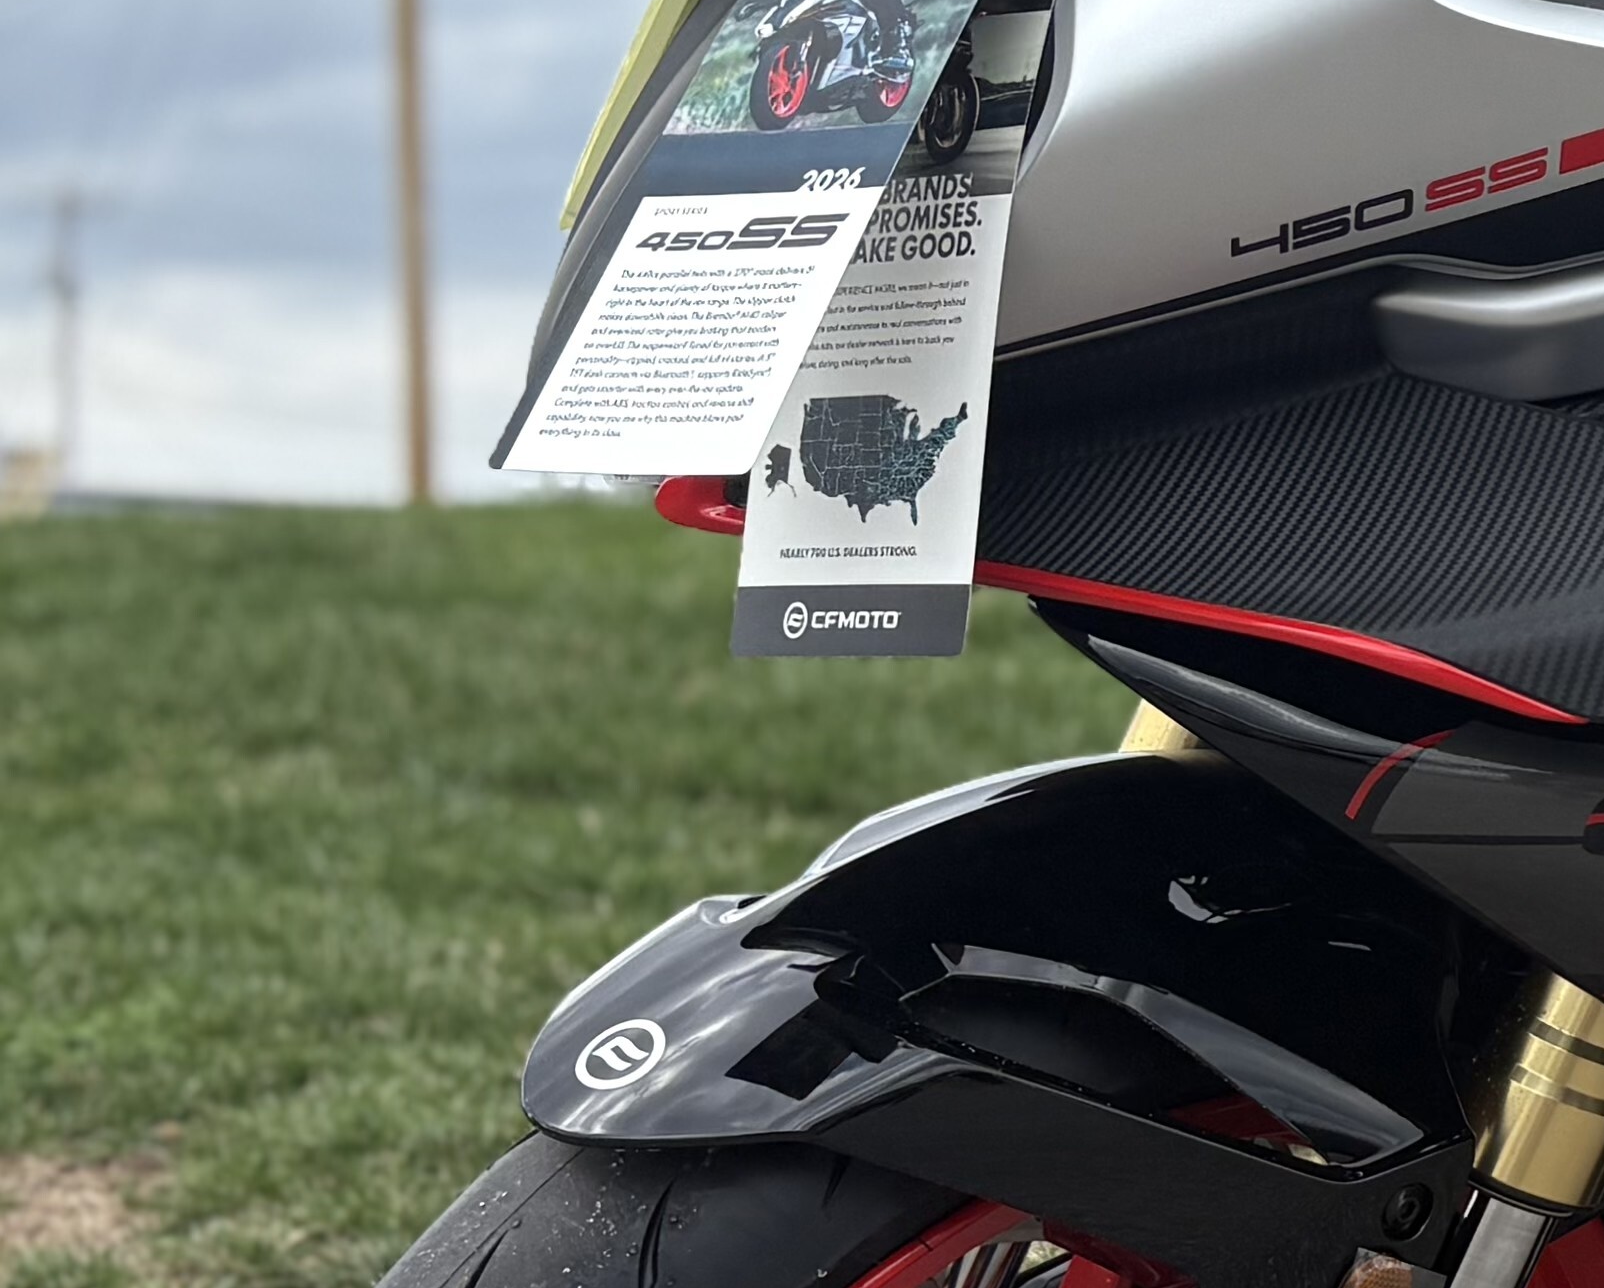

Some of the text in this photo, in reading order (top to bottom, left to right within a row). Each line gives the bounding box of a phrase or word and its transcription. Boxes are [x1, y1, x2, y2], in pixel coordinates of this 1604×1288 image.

[802, 167, 866, 191] 2026
[636, 212, 850, 251] 450SS
[864, 201, 982, 235] PROMISES.
[900, 230, 975, 261] GOOD.
[811, 610, 900, 630] CFMOTO
